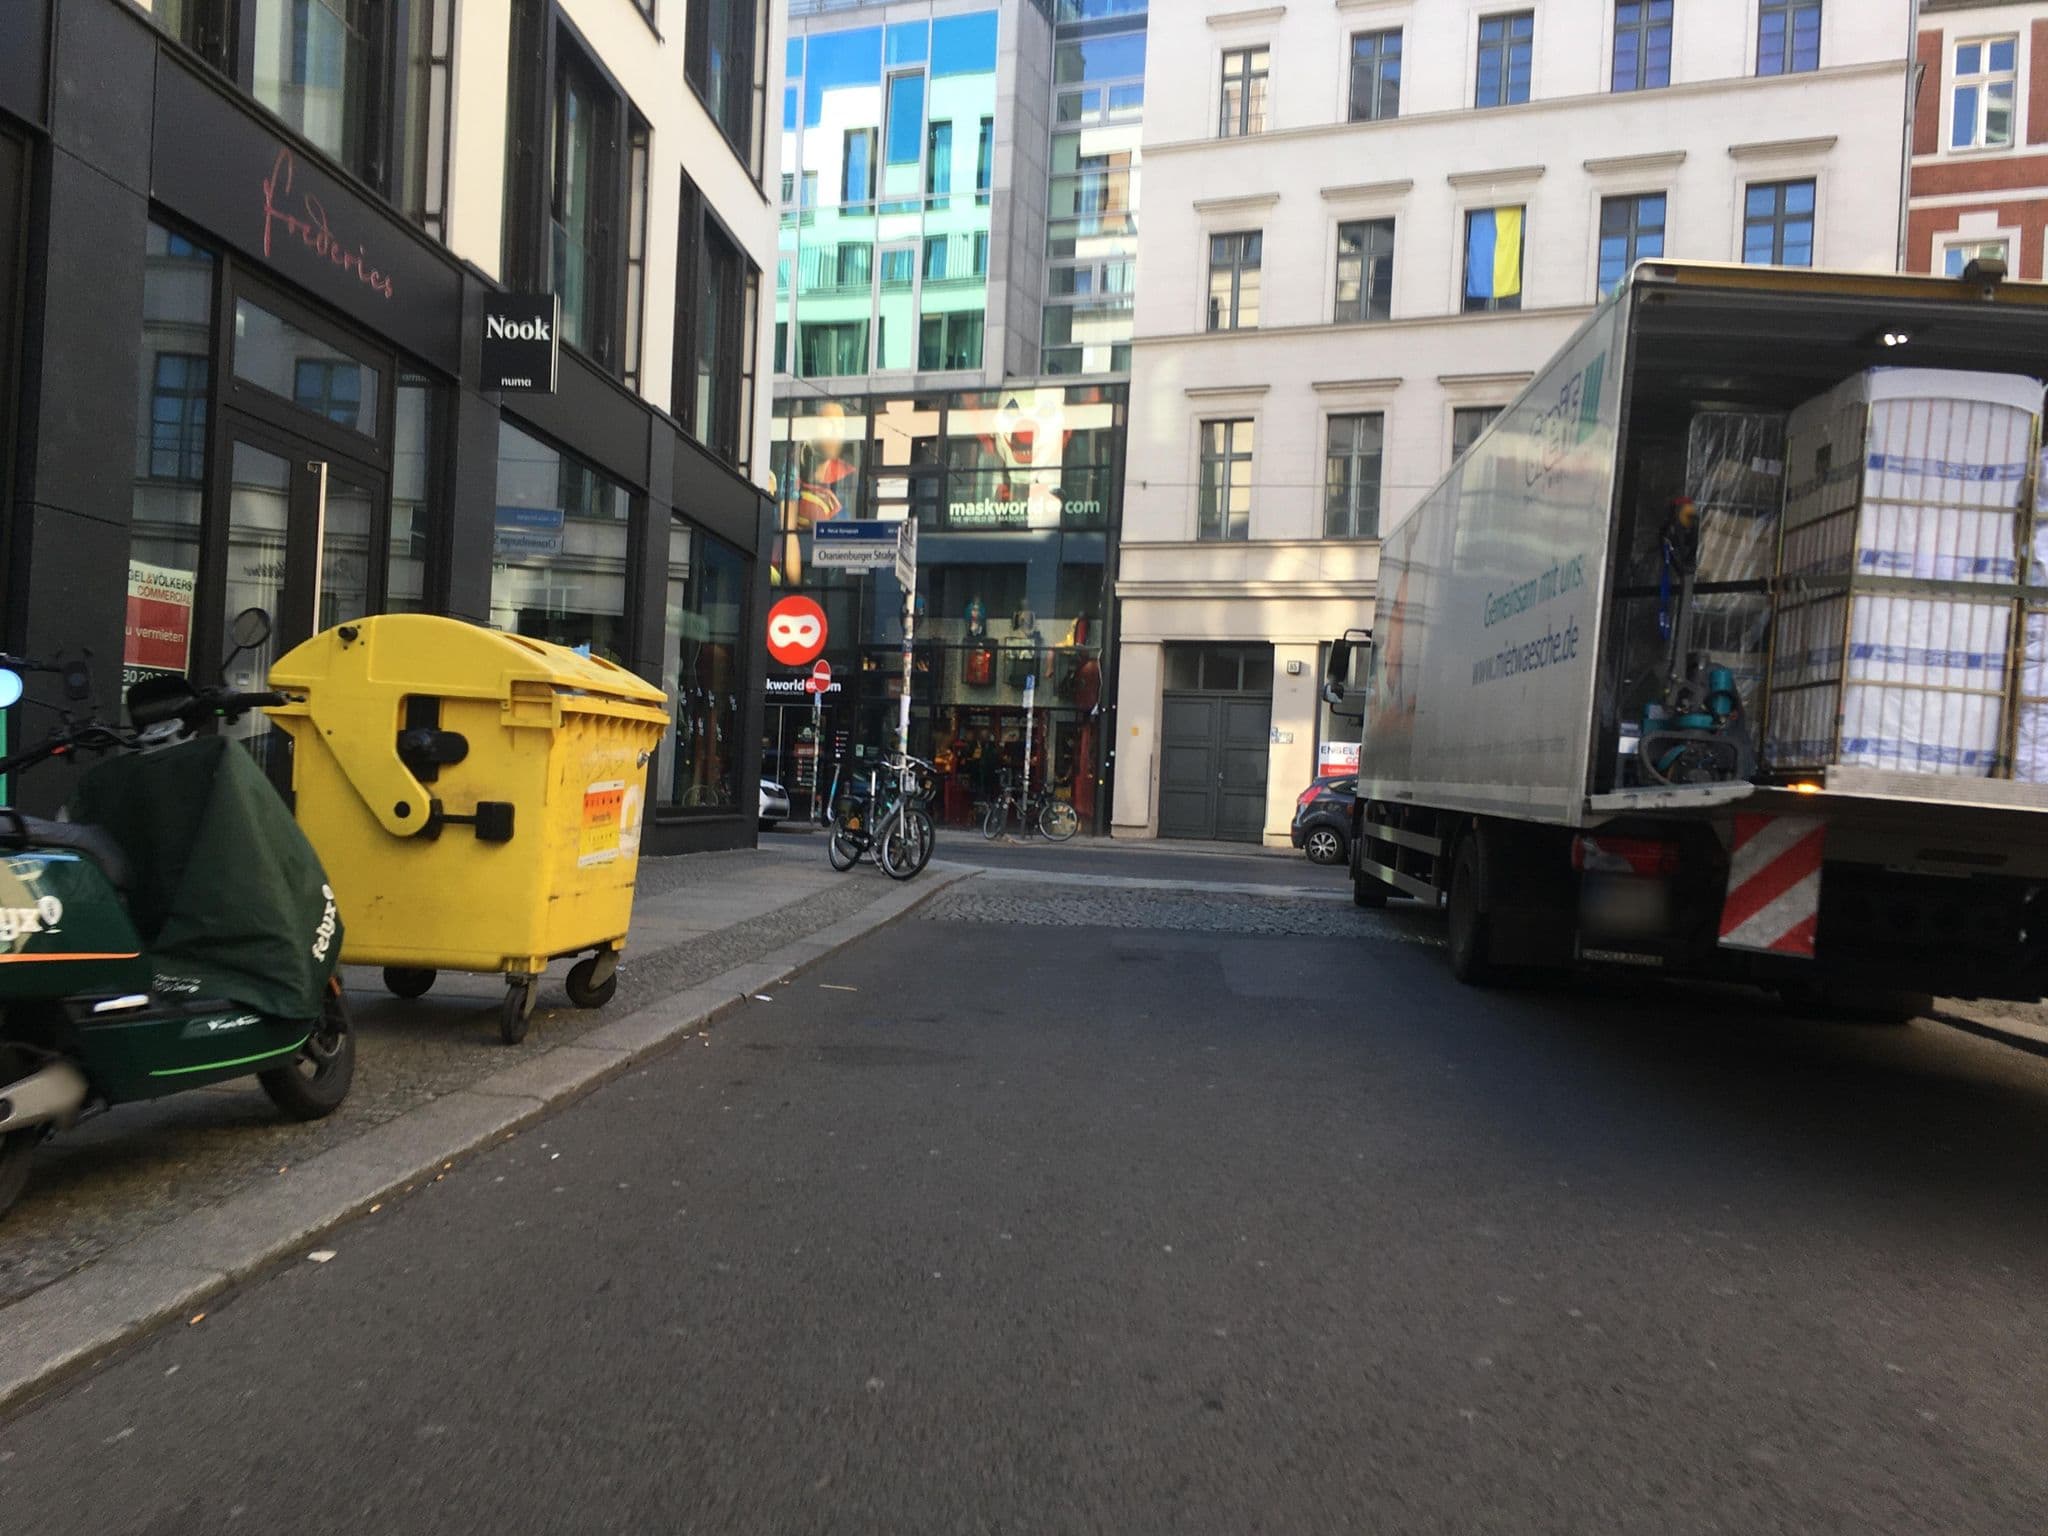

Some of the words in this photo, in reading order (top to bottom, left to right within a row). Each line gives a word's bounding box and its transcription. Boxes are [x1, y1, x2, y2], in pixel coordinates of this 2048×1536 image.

[487, 314, 550, 340] Nook
[501, 377, 531, 387] numa
[818, 549, 872, 563] Oranienburger
[137, 585, 192, 605] COMMERCIAL
[135, 626, 184, 643] vermieten
